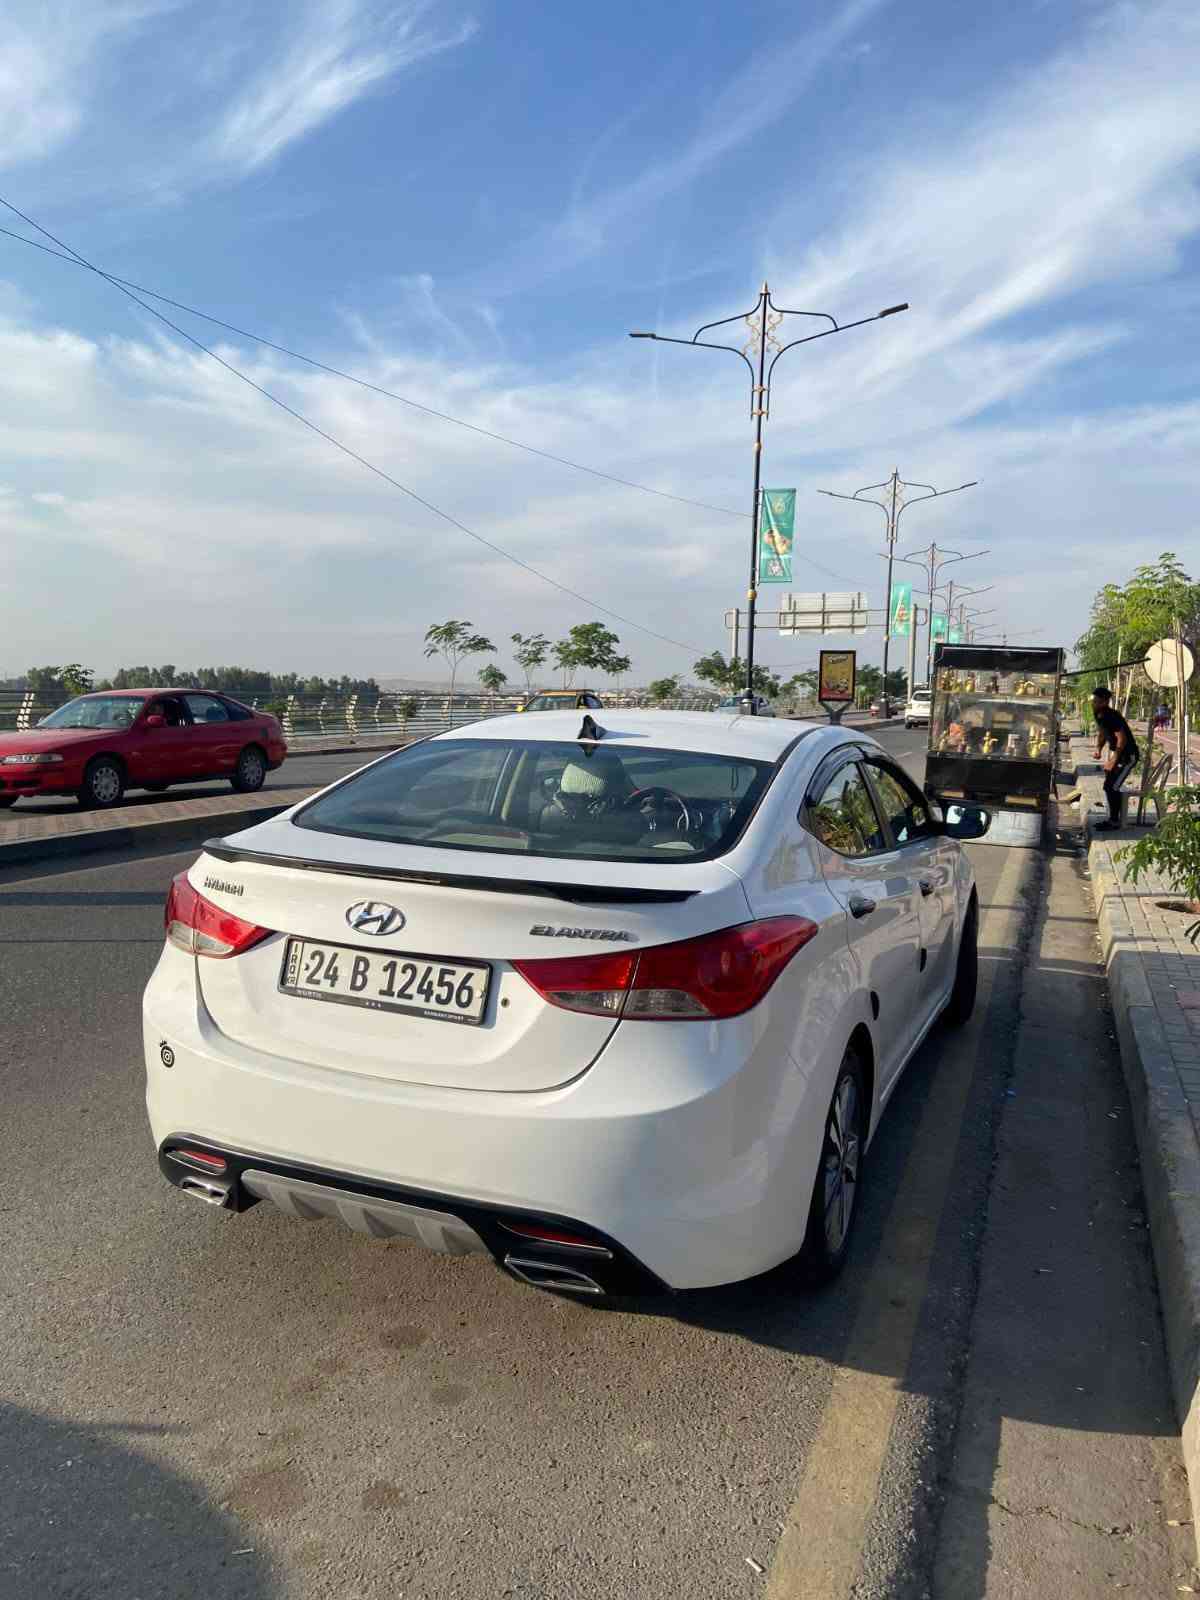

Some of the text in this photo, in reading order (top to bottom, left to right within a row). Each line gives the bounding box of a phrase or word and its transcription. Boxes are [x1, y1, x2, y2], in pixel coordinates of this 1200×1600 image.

[529, 925, 640, 942] ELANTRA
[305, 950, 475, 1009] 24 B 12456
